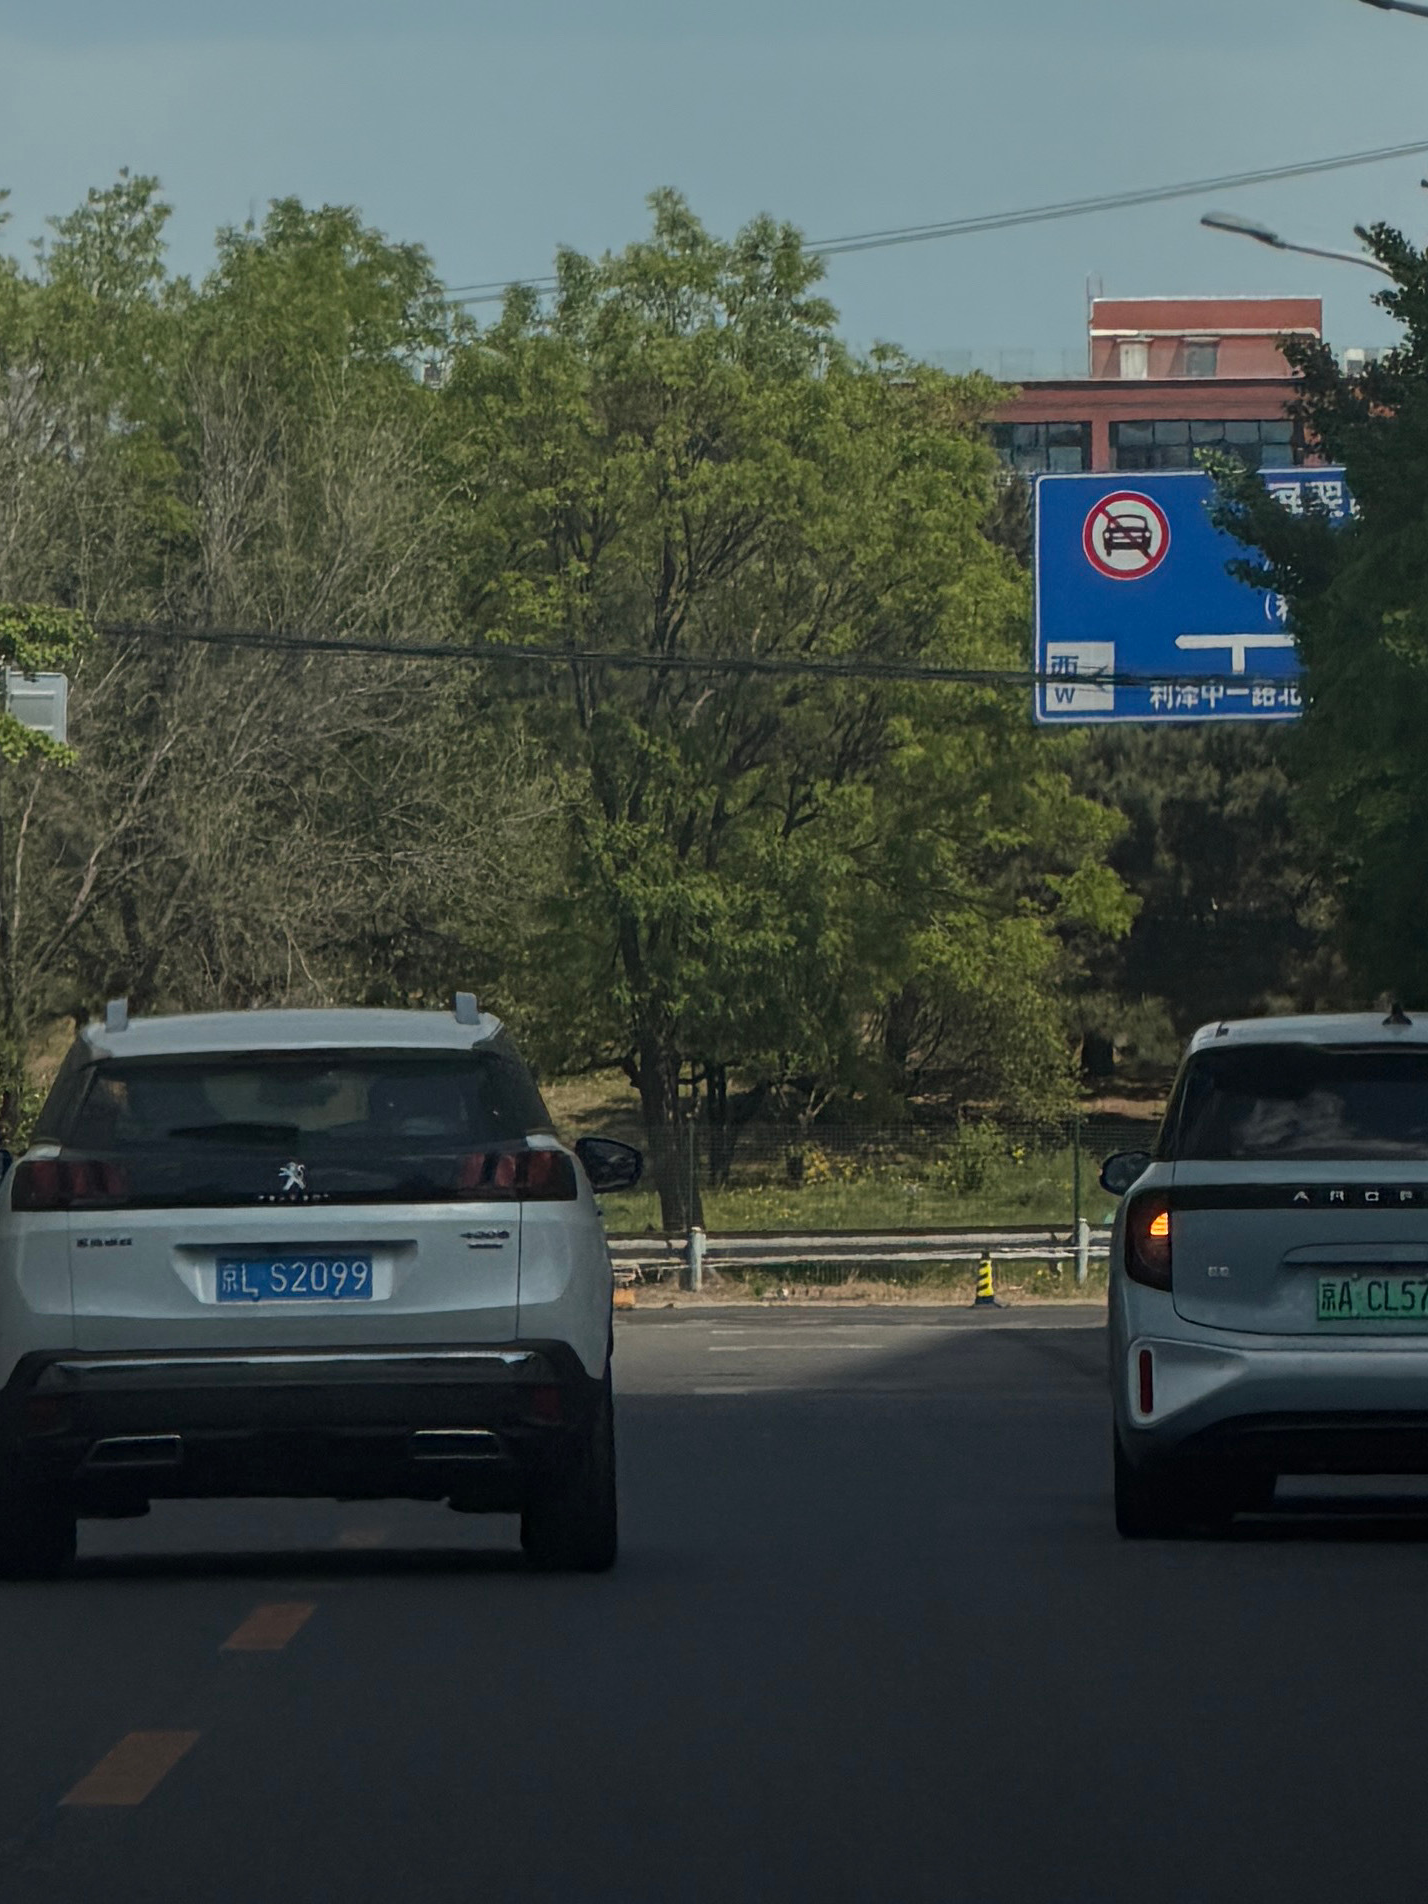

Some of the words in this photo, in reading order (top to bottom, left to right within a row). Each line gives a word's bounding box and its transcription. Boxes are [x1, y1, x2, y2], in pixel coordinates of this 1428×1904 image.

[1054, 686, 1076, 704] W
[222, 1264, 258, 1297] 京L
[270, 1260, 369, 1295] S2099
[1321, 1281, 1353, 1312] 京A
